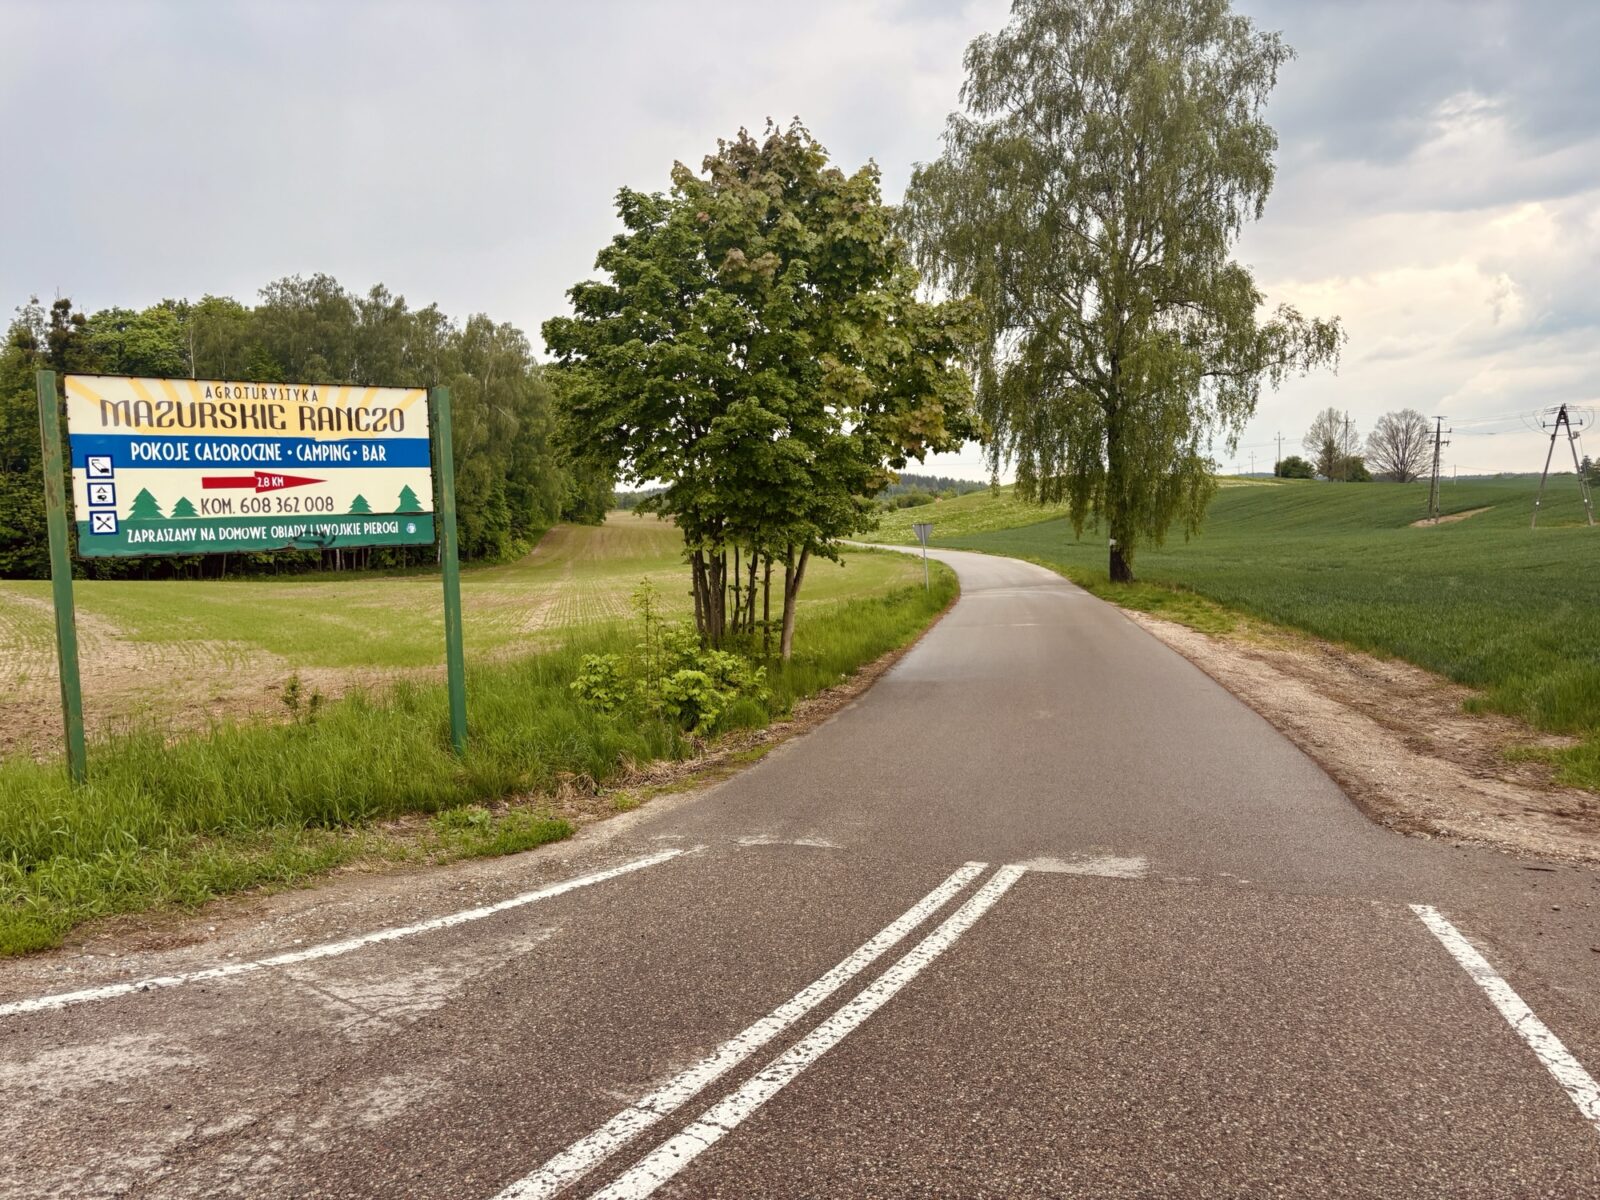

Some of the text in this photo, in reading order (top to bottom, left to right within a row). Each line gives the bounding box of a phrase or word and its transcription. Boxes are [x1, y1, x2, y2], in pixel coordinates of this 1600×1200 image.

[205, 385, 319, 402] AGROTURYSTYKA
[100, 399, 405, 433] MAZURSKIE RANCZO
[131, 442, 387, 461] POKOJE CAŁOROCZNE CAMPING BAR
[272, 477, 284, 487] KM
[201, 496, 335, 515] KOM. 608 362 008
[127, 527, 197, 543] ZAPRASZAMY
[201, 527, 216, 541] NA
[219, 525, 267, 541] DOMOWE
[271, 524, 307, 538] OBIADY
[363, 521, 399, 535] PIEROGI
